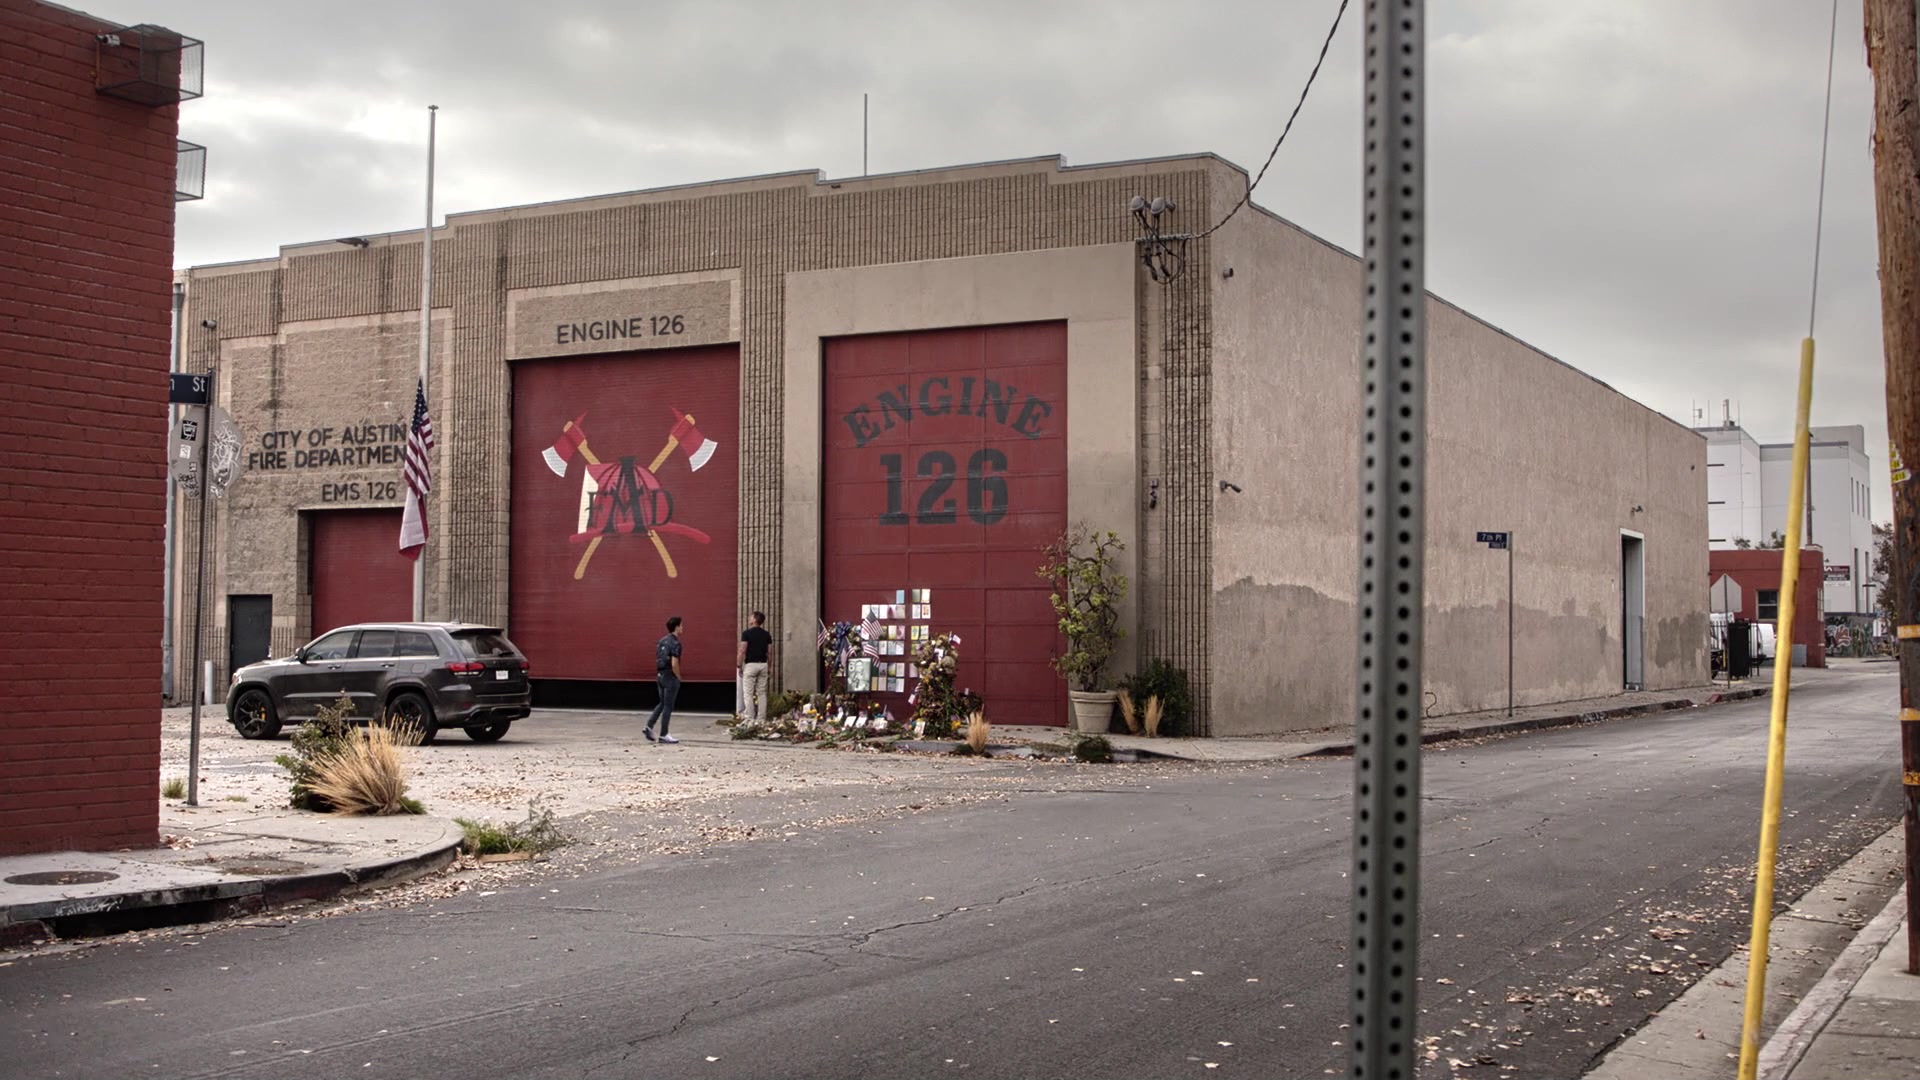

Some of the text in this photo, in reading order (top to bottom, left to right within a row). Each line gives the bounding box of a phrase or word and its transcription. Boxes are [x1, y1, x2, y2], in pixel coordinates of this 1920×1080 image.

[557, 315, 684, 344] ENGINE 126
[192, 376, 205, 392] St
[843, 376, 1053, 448] ENGINE
[262, 423, 407, 450] CITY OF AUSTIN
[249, 445, 408, 470] FIRE DEPARTMEN
[322, 481, 397, 501] EMS 126
[879, 448, 1009, 525] 126
